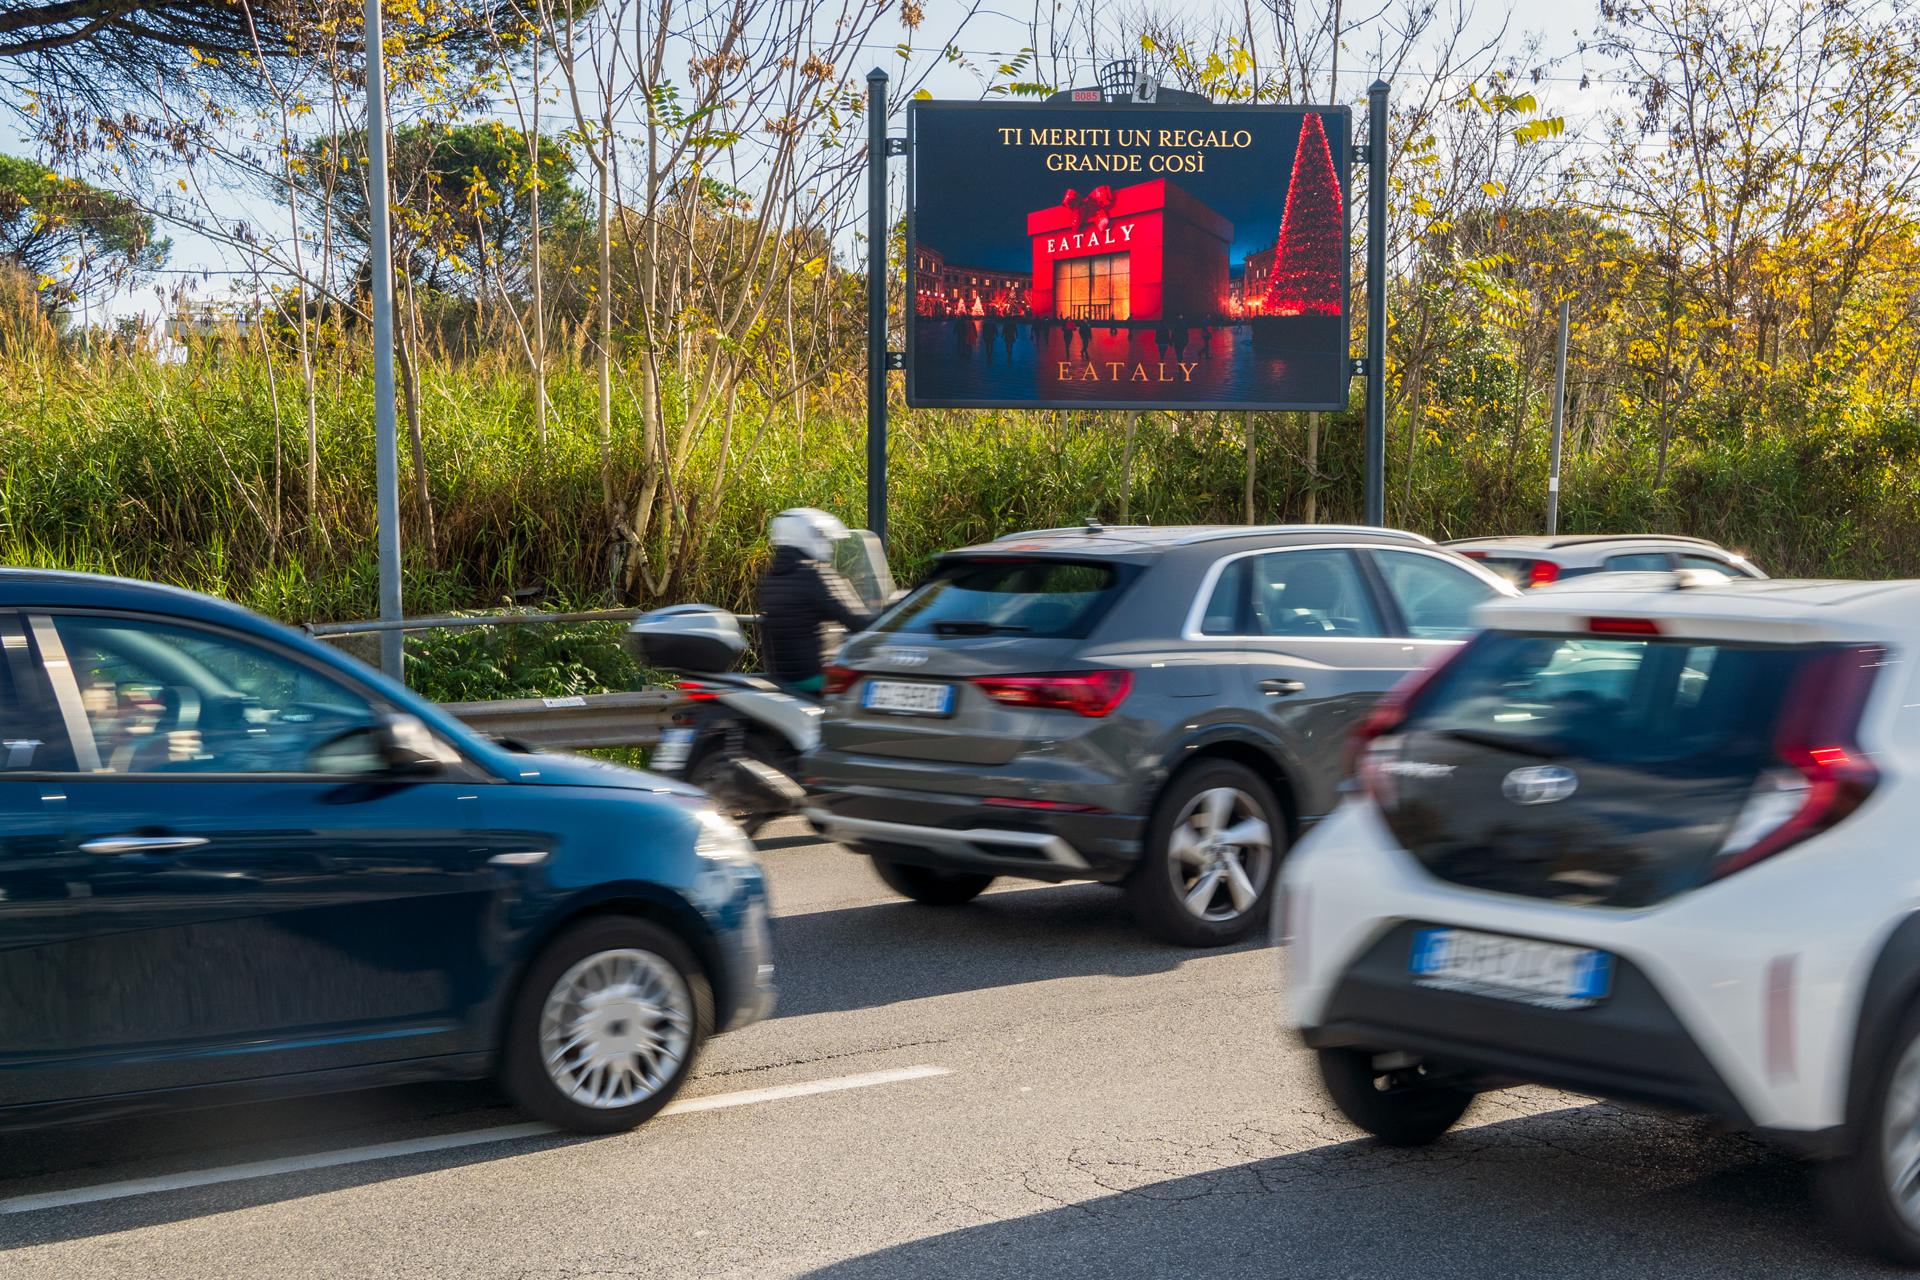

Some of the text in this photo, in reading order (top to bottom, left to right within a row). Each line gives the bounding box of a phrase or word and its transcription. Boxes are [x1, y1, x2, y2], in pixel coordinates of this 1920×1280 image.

[1074, 91, 1098, 100] 8085
[998, 128, 1252, 148] TI MERITI UN REGALO
[1046, 150, 1205, 173] GRANDE COSÌ
[1047, 223, 1135, 253] EATALY
[1057, 361, 1198, 382] EATALY
